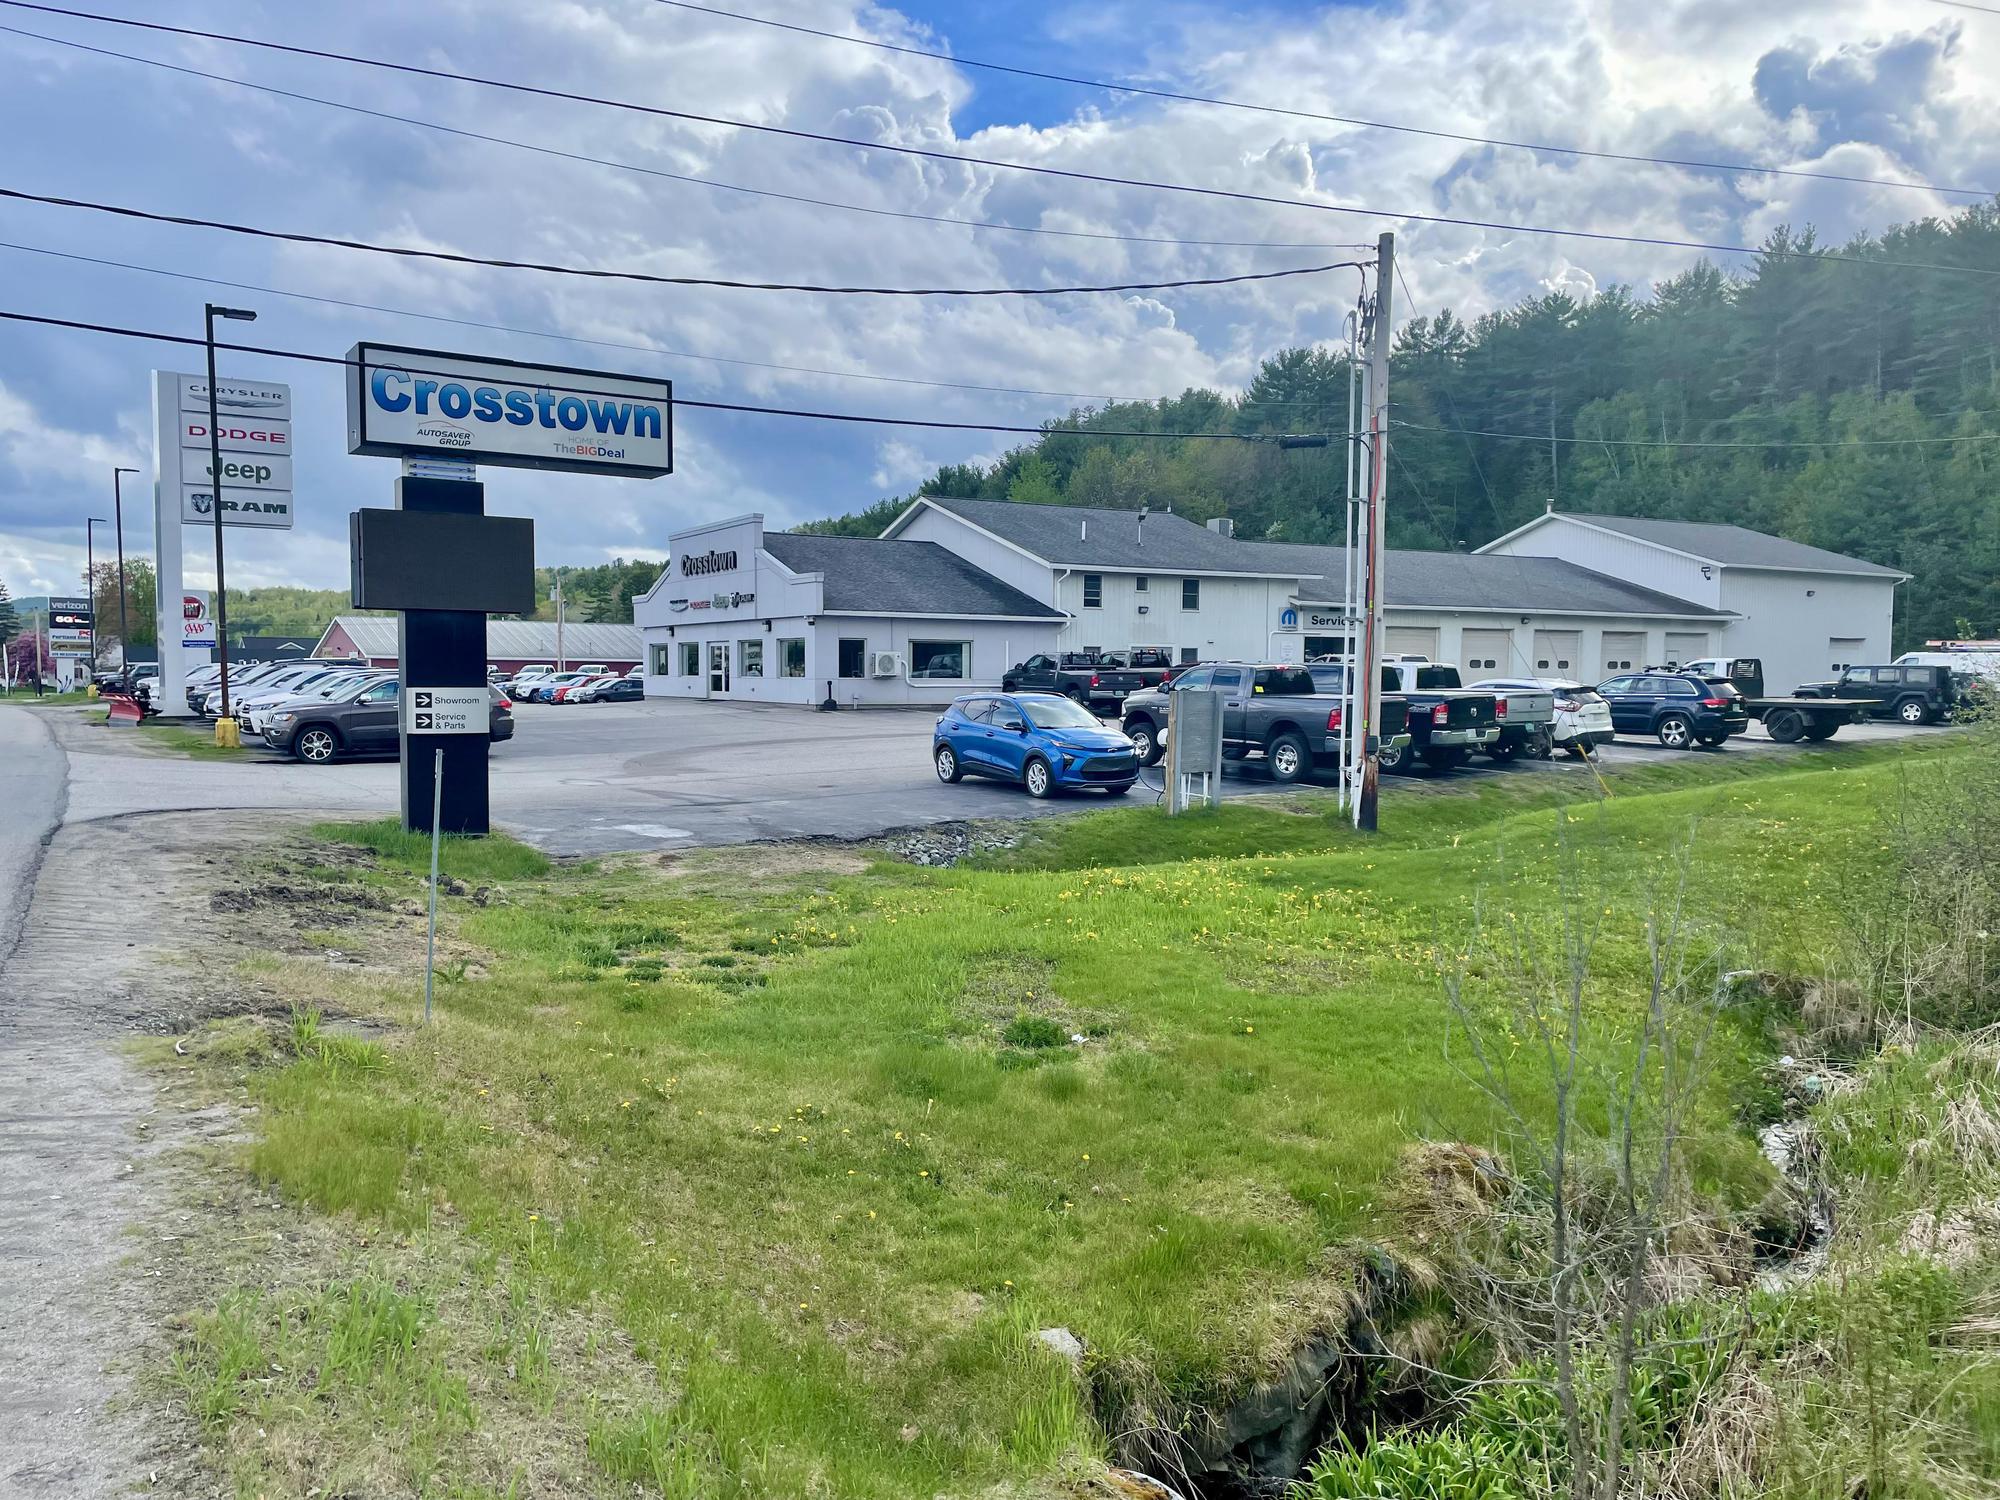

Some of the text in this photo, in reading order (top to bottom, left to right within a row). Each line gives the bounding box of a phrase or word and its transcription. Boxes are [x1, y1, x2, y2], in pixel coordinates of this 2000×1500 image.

[189, 385, 282, 399] CHRYSLER
[371, 364, 662, 439] Crosstown
[189, 426, 286, 443] DODGE
[417, 429, 471, 440] AUTOSAVER
[568, 436, 609, 446] HOME OF
[439, 438, 471, 448] GROUP
[206, 457, 272, 484] Jeep
[219, 500, 287, 514] RAM
[680, 550, 738, 577] Crosstown
[51, 601, 88, 610] verizon
[434, 696, 480, 704] Showroom
